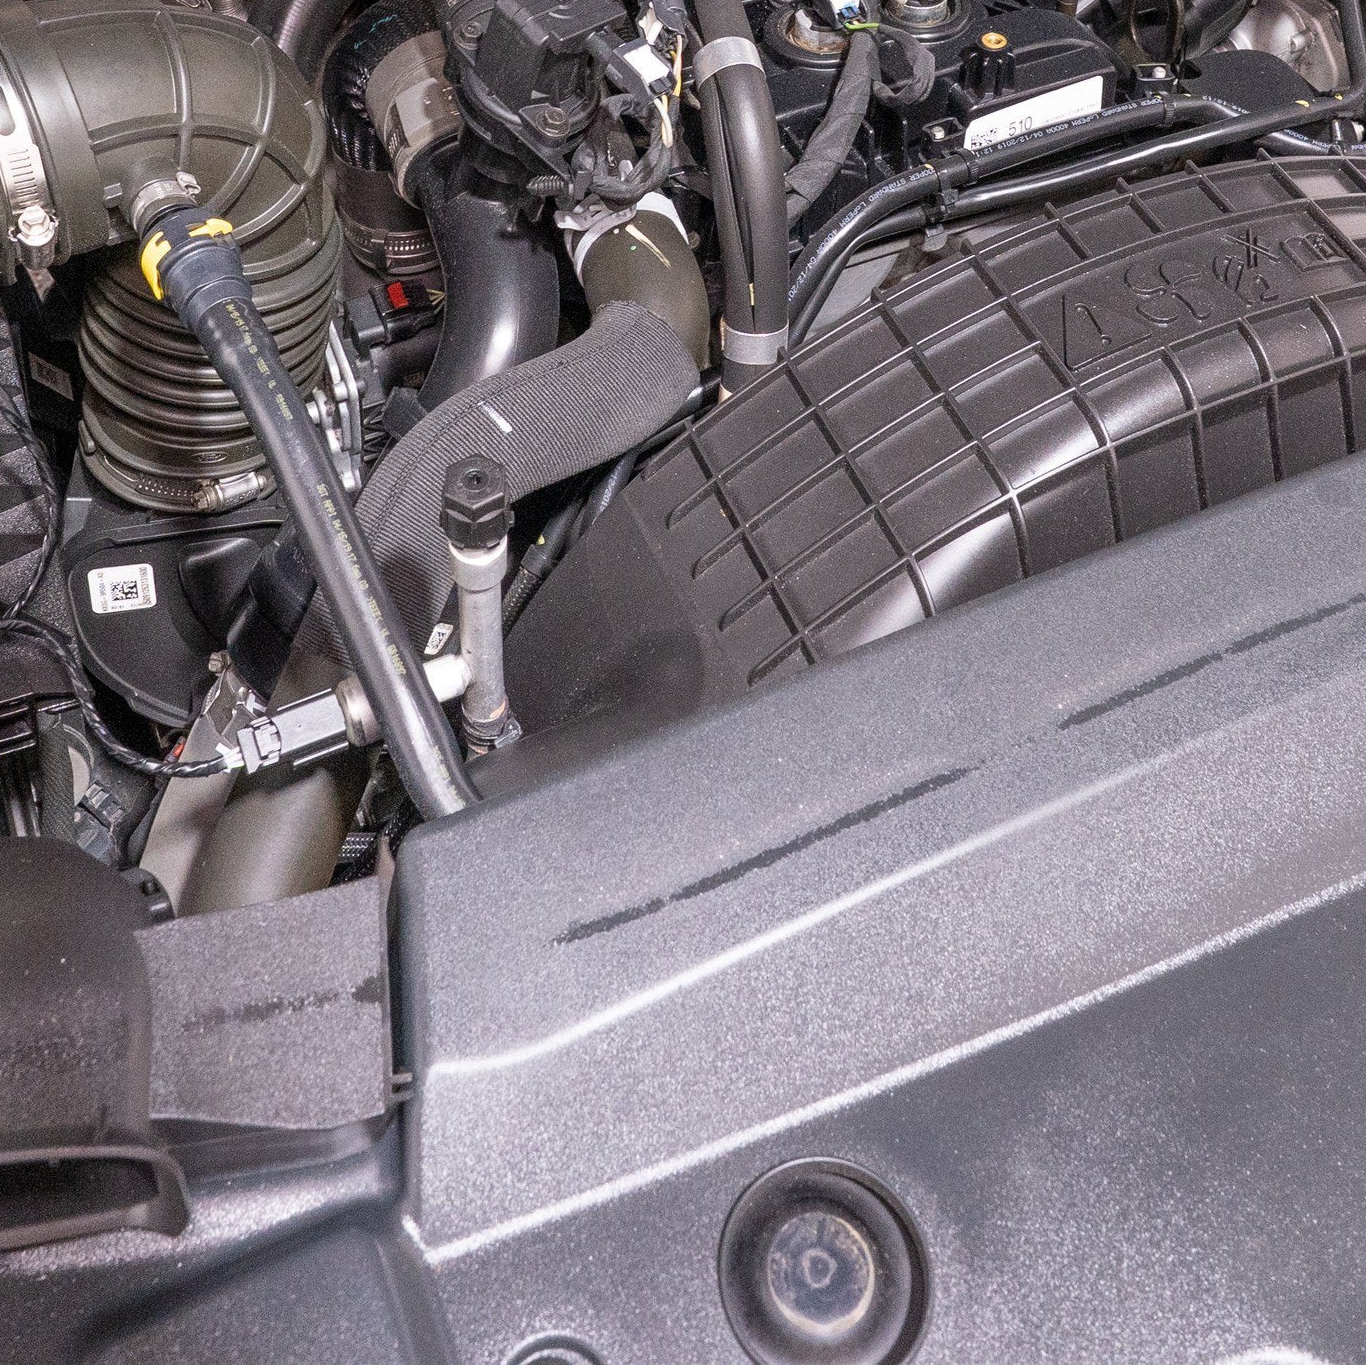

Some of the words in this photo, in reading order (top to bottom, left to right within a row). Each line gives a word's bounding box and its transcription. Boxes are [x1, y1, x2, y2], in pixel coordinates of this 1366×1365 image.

[1101, 102, 1138, 118] STANDARD
[1008, 117, 1034, 135] 510
[1045, 122, 1070, 135] 4000A
[997, 130, 1043, 151] 04/12/2019
[866, 176, 907, 204] STANDARD
